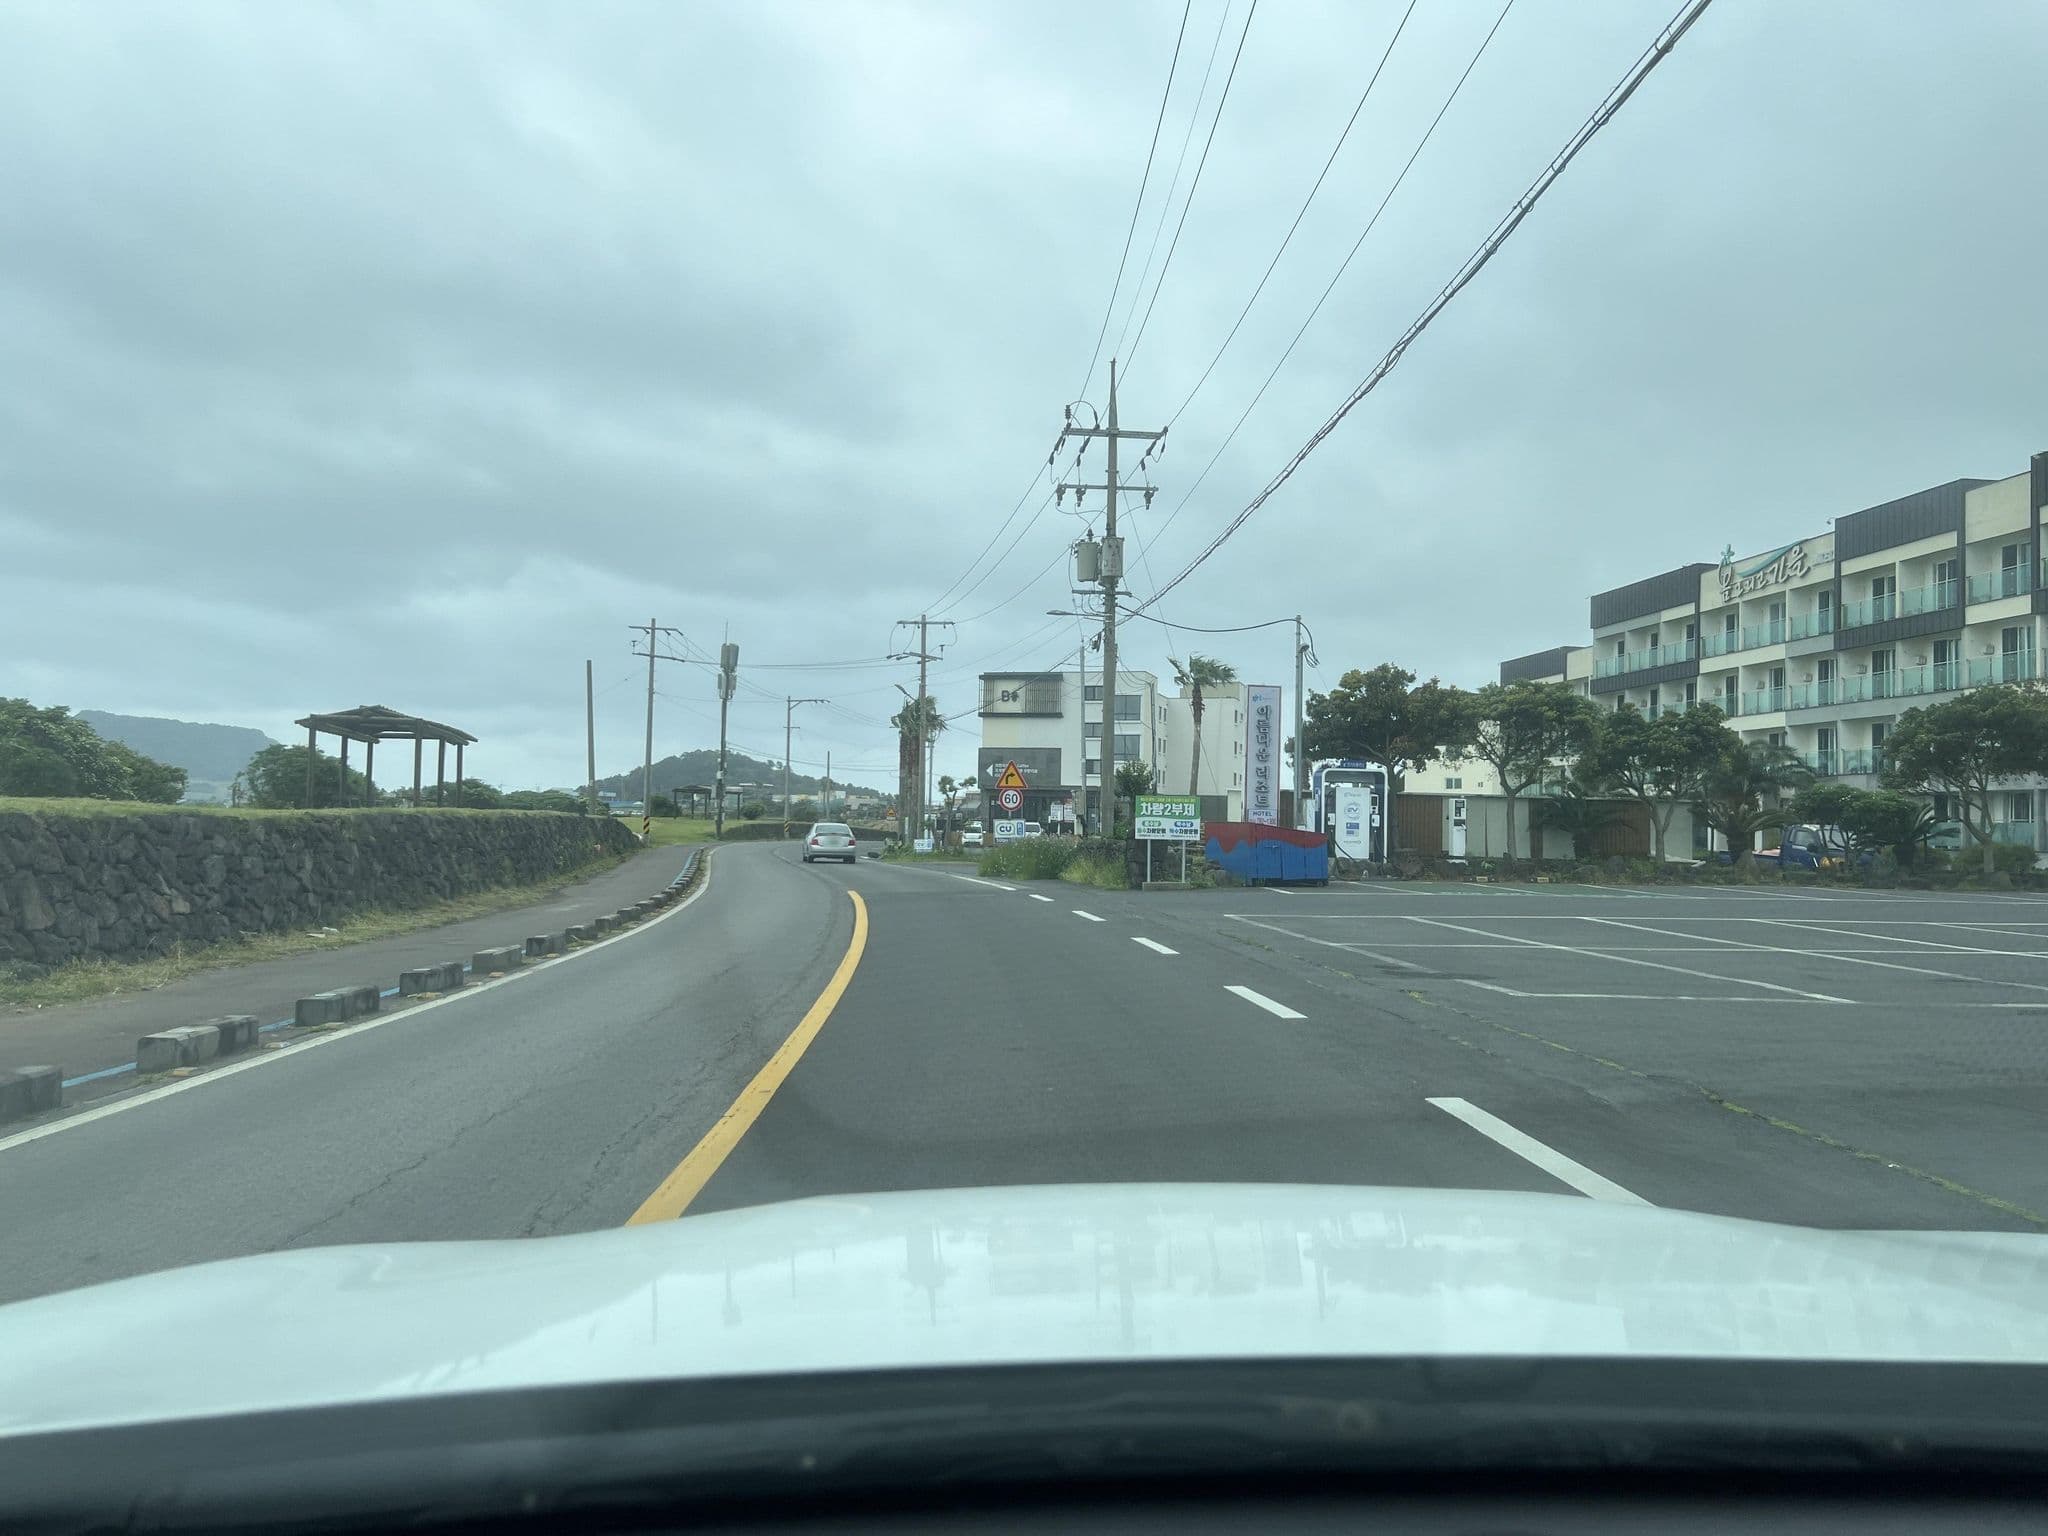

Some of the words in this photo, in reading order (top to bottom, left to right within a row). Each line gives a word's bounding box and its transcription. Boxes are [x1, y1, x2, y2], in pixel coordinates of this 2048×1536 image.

[1256, 704, 1273, 763] 아름다운
[1254, 766, 1271, 809] 리조트
[1004, 793, 1018, 804] 60
[1140, 802, 1195, 817] 차량2부제
[999, 825, 1012, 833] CU
